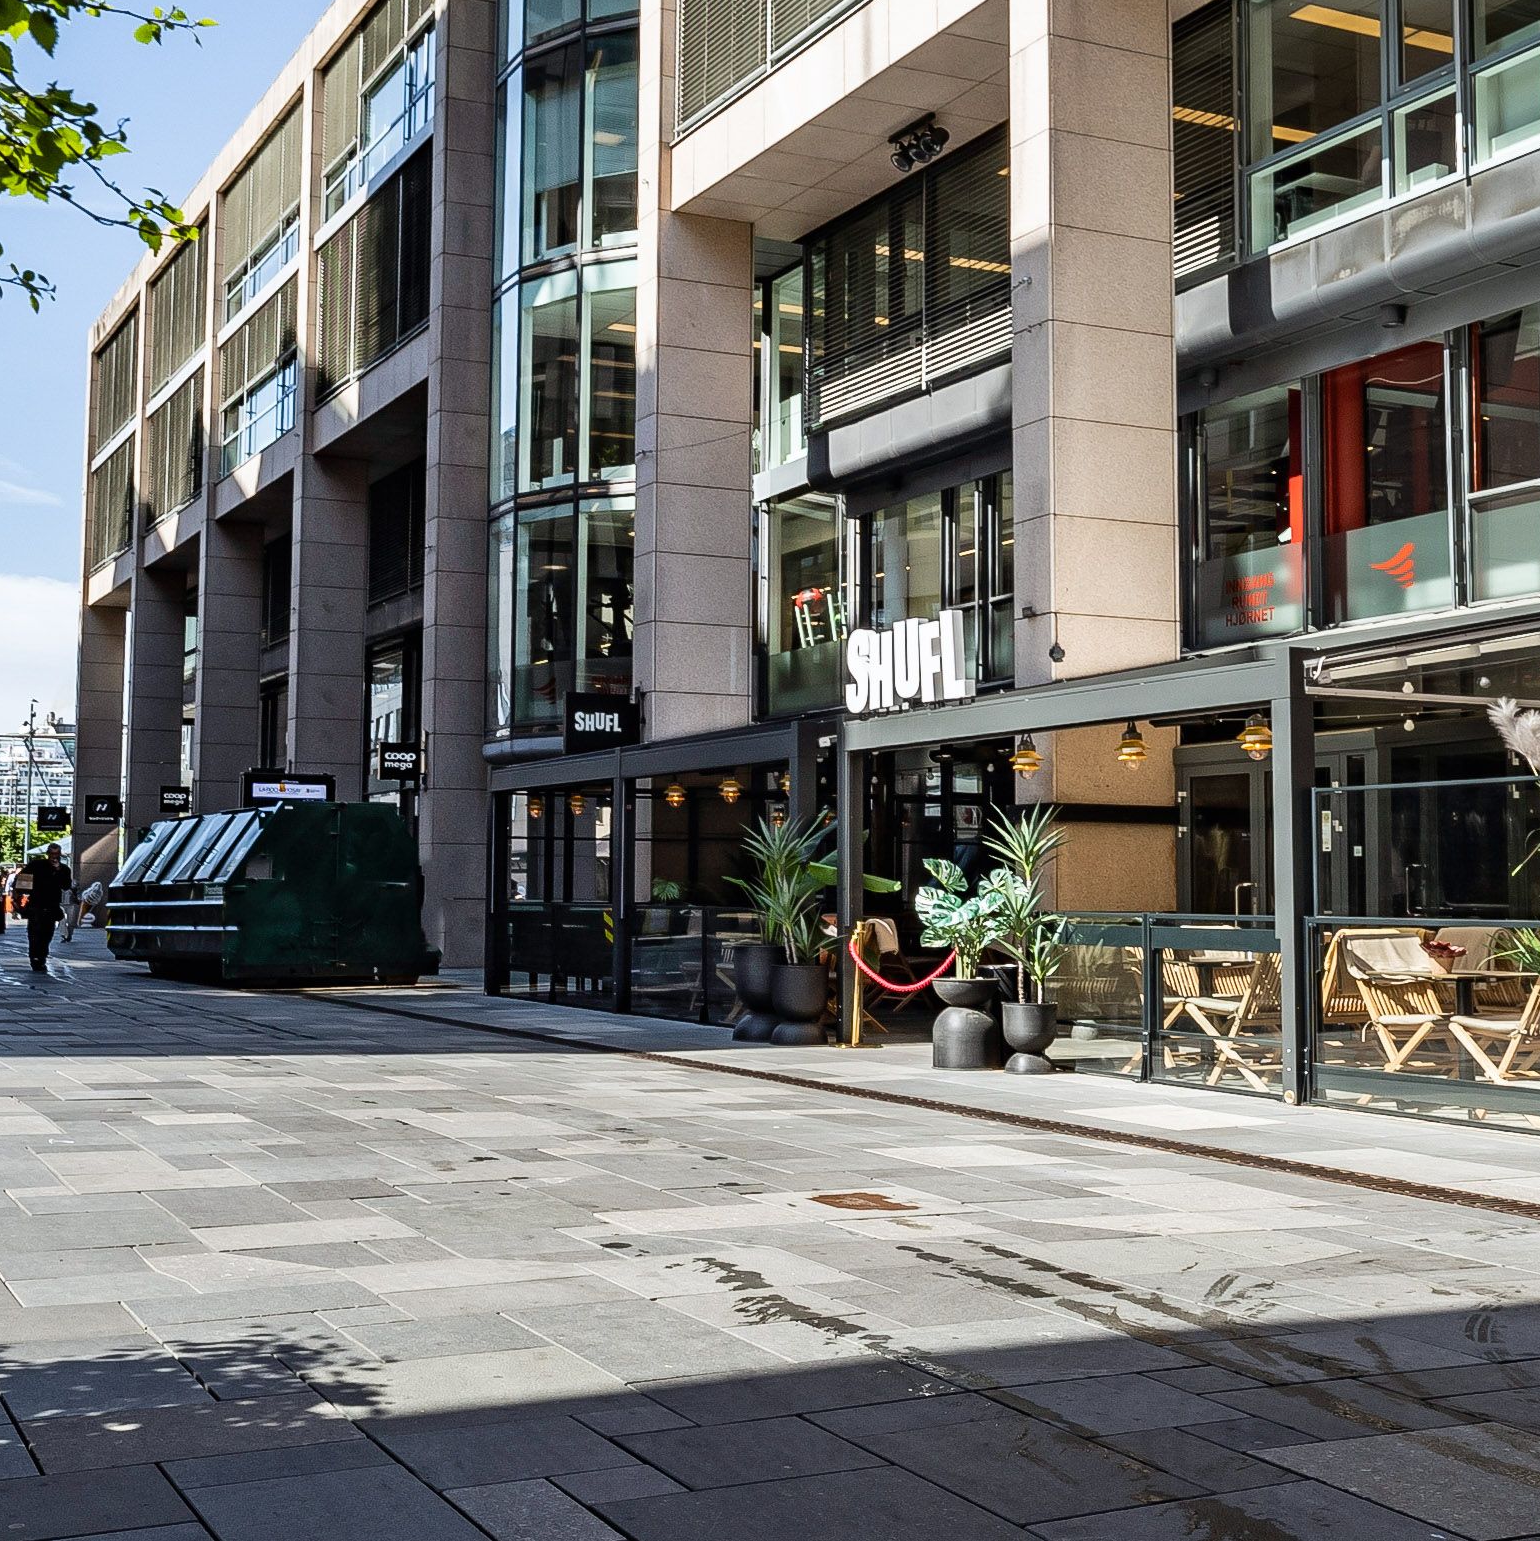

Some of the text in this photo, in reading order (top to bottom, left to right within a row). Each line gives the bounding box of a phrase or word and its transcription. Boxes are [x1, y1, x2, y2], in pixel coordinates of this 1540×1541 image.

[1225, 606, 1275, 627] HJØRNET
[845, 609, 971, 714] SHUFL
[574, 711, 622, 732] SHUFL
[385, 752, 416, 761] coop
[385, 762, 413, 770] mega
